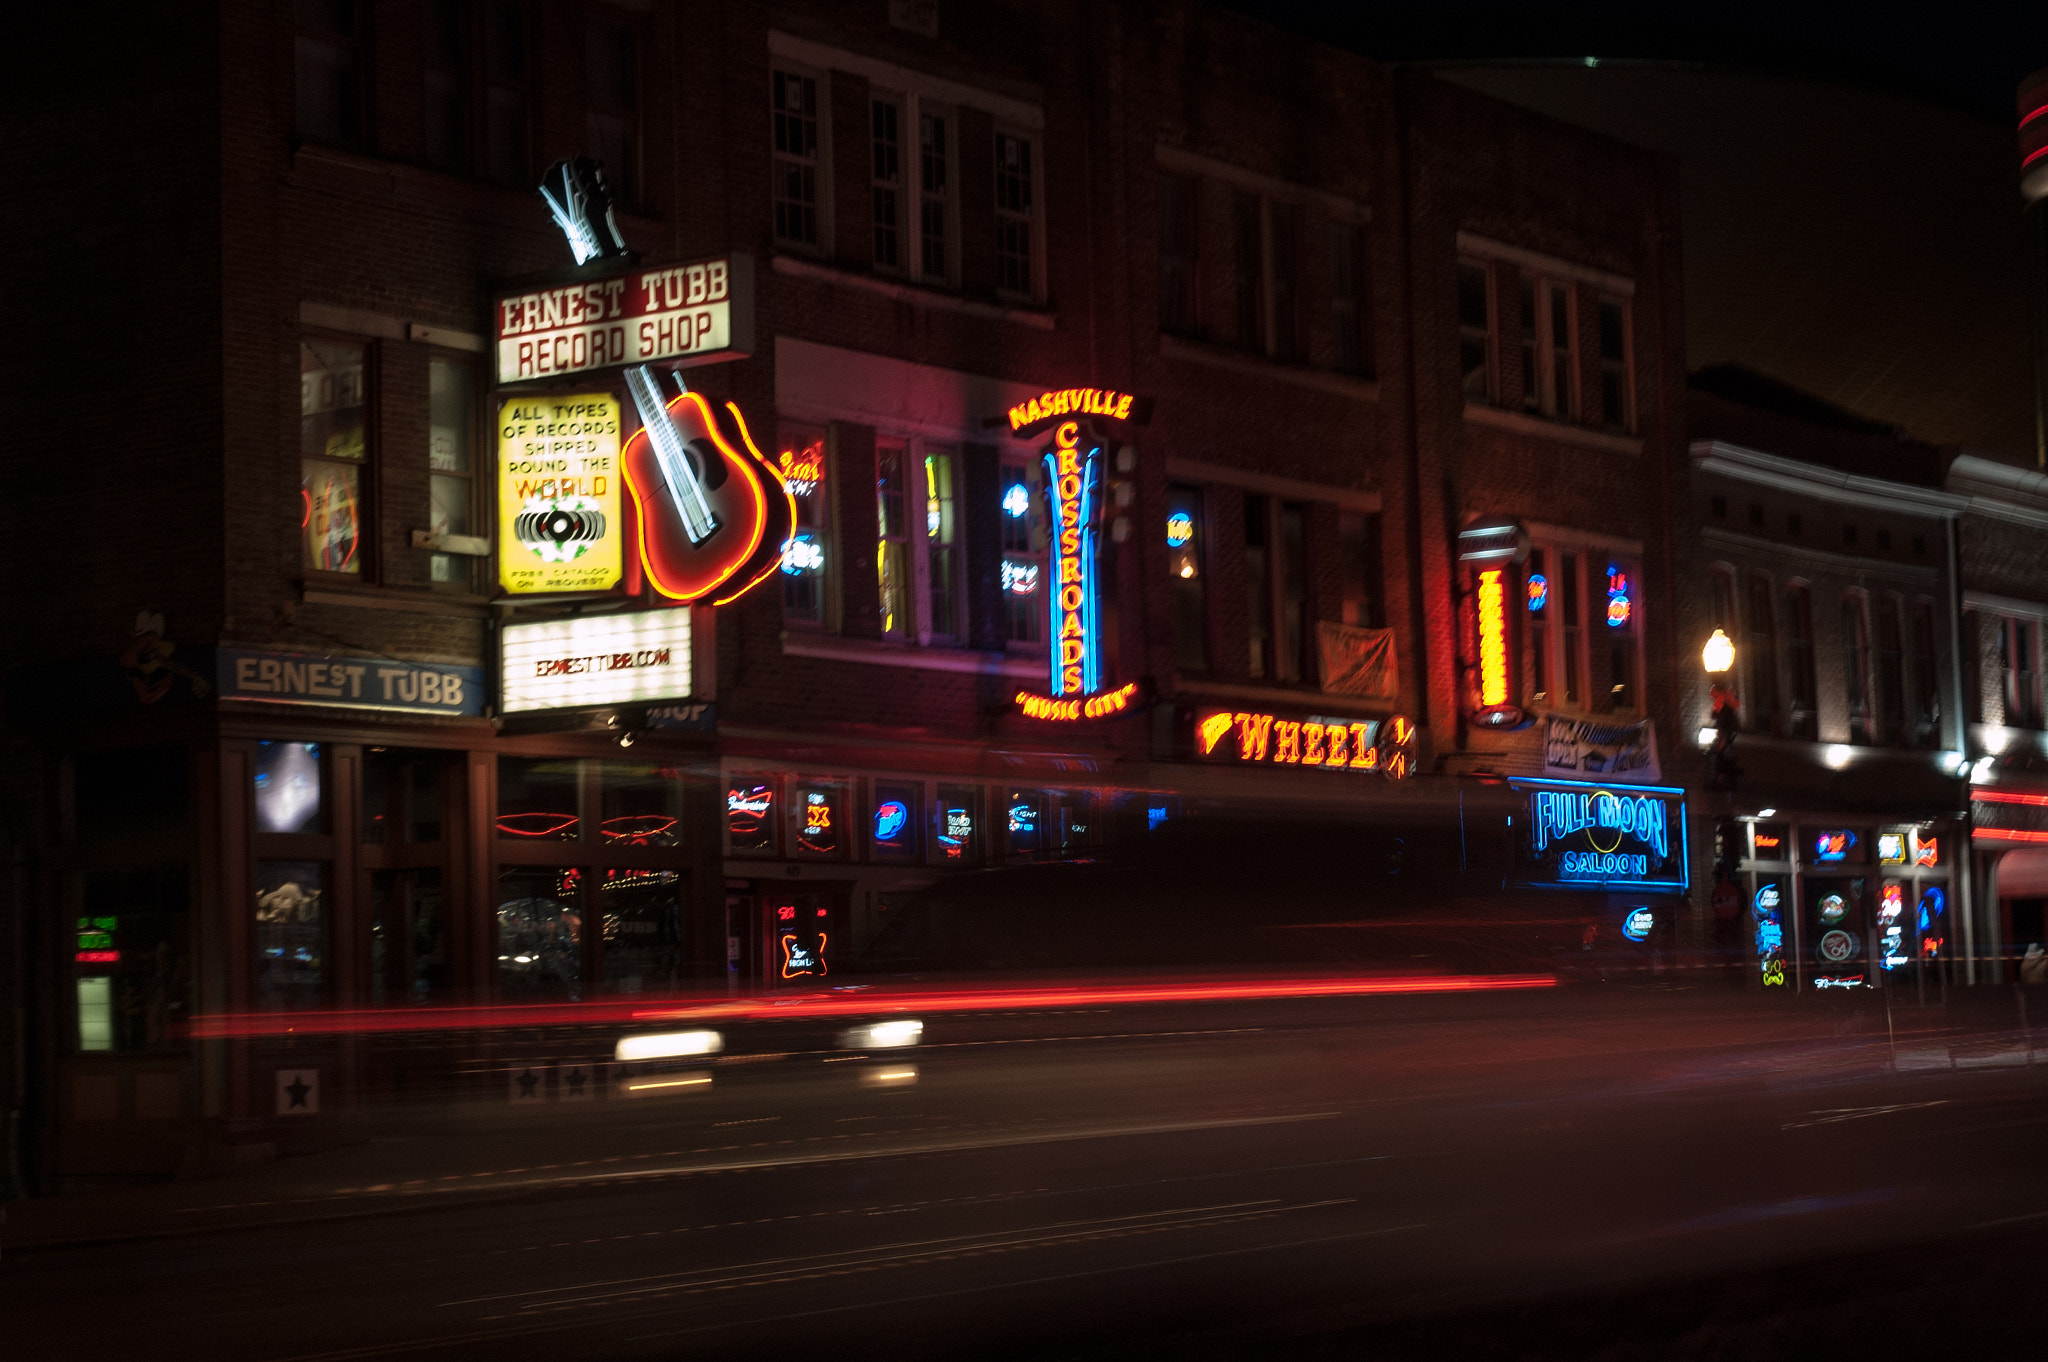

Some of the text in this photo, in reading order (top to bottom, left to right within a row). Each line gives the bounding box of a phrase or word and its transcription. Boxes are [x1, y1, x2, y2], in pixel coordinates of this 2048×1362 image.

[501, 259, 729, 336] ERNEST TUBB
[517, 312, 712, 378] RECORD SHOP
[503, 420, 616, 439] OF RECORDS
[511, 403, 608, 422] ALL TYPES
[1008, 388, 1134, 431] NASHVILLE
[508, 457, 611, 474] ROUND THE
[525, 440, 598, 456] SHIPPED
[514, 476, 607, 499] WORLD
[1055, 420, 1085, 694] CROSSROADS
[235, 658, 465, 706] ERNEST TUBB
[1233, 712, 1378, 769] WHEEL
[1537, 791, 1668, 859] FULL MOON
[1564, 850, 1647, 876] SALOON
